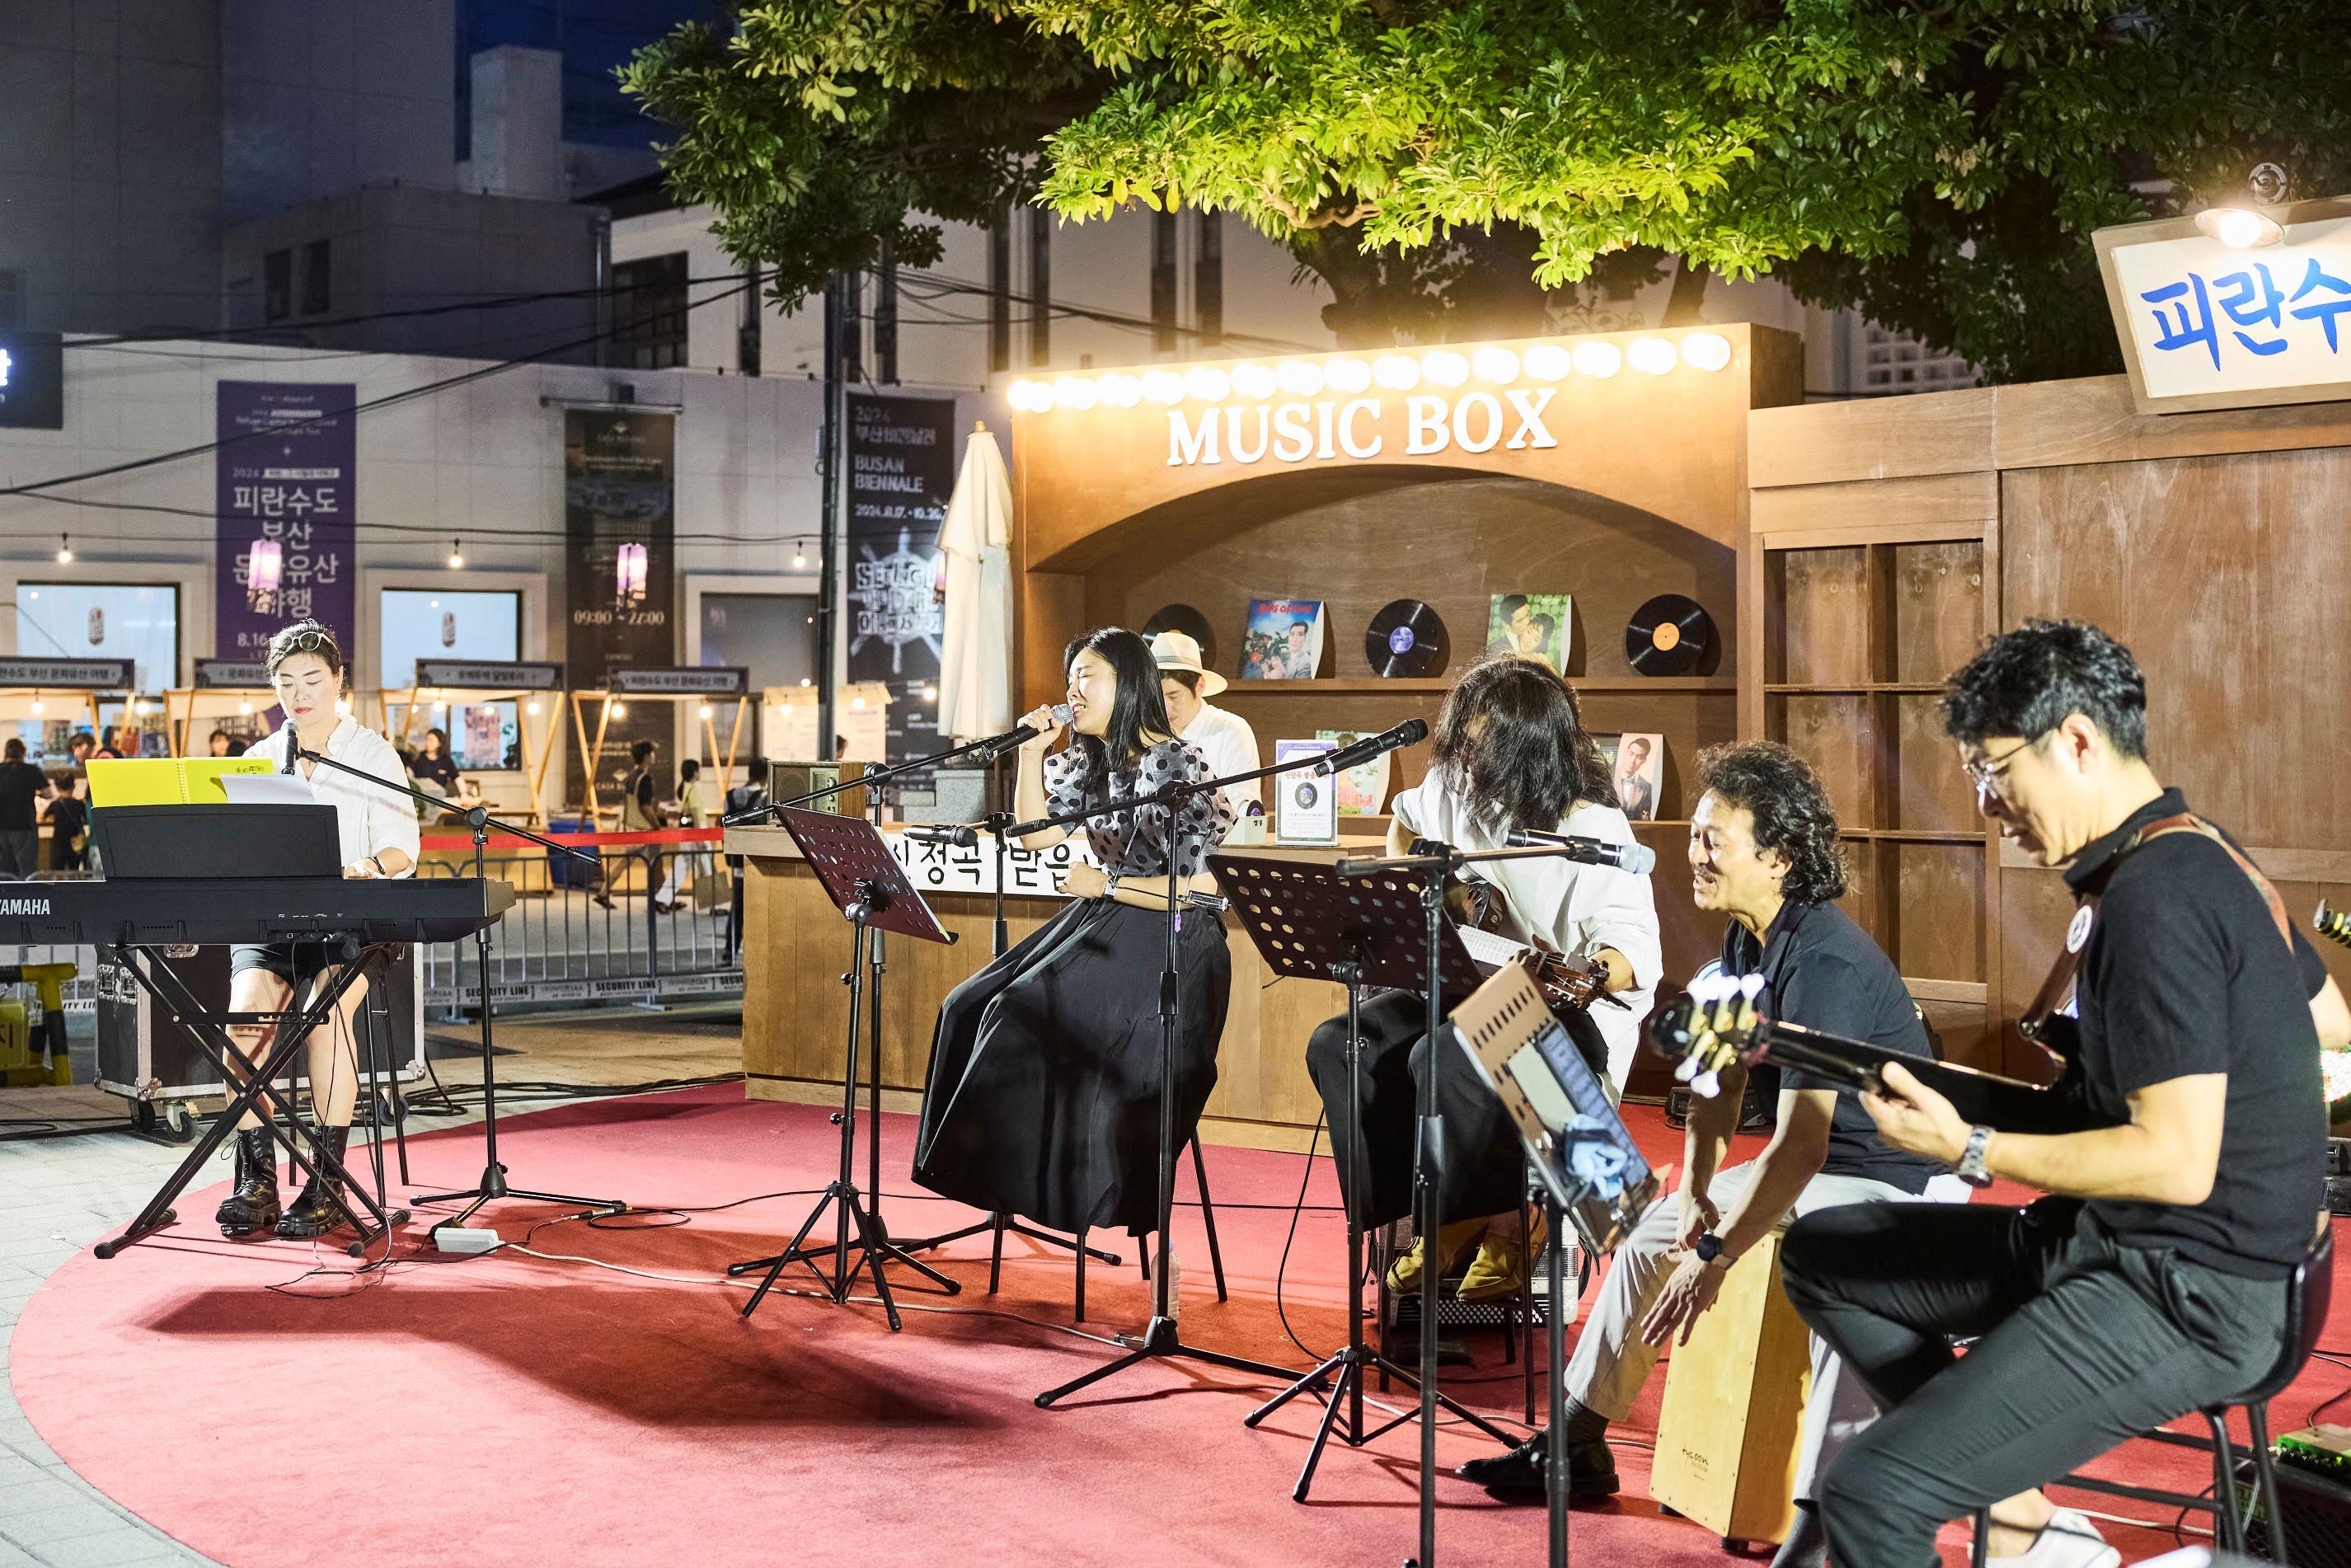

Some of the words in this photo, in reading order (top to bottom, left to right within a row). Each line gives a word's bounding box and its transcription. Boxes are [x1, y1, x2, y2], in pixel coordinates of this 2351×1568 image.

[1166, 398, 1382, 467] MUSIC
[1405, 387, 1559, 456] BOX
[855, 454, 905, 473] BUSAN
[855, 473, 924, 493] BIENNALE
[232, 485, 339, 517] 피란수도
[574, 609, 613, 625] 09:00
[510, 984, 529, 996] LINE
[596, 979, 636, 992] SECURITY
[638, 978, 656, 990] LINE
[1682, 1441, 1709, 1466] tycoon
